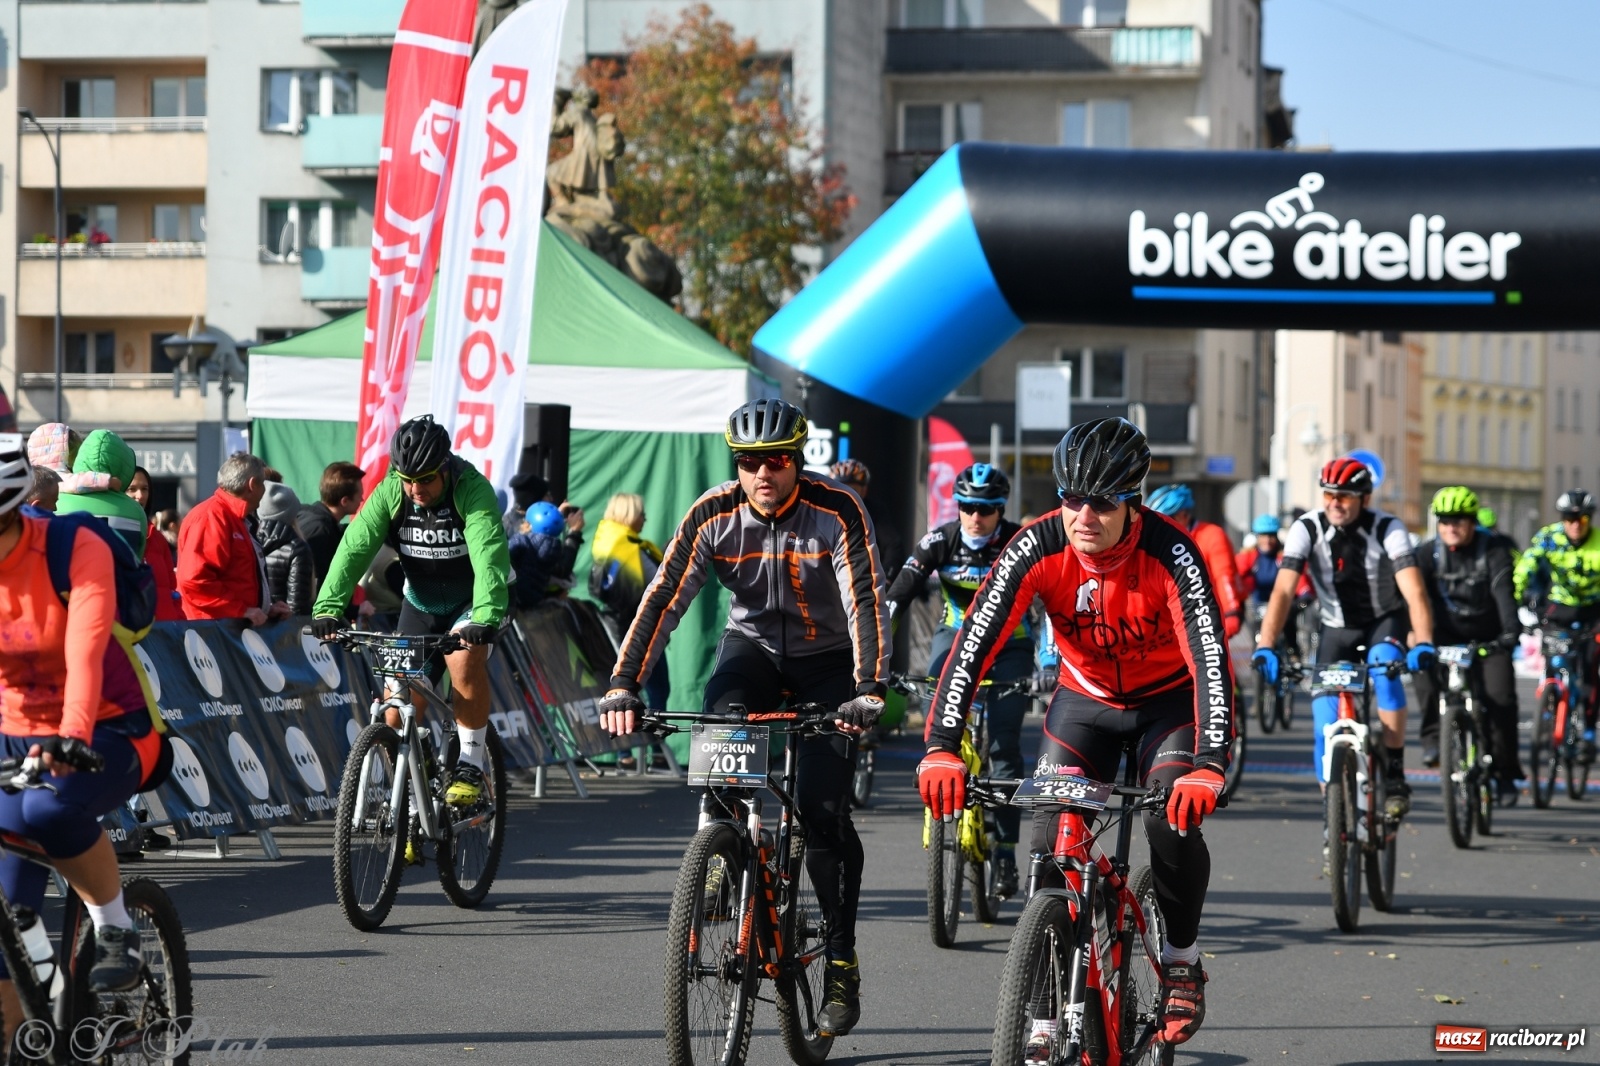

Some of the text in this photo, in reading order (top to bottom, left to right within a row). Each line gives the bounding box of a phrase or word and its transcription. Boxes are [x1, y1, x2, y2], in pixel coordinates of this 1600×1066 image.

[1128, 209, 1521, 281] bike atelier
[454, 64, 529, 482] RACIBÓR
[412, 527, 464, 544] BORA
[411, 548, 461, 558] hansgrohe
[942, 528, 1039, 728] opony-serafinowski.pl
[378, 648, 415, 657] OPIEKUN
[383, 656, 411, 670] 274
[199, 701, 243, 717] KOKOwear
[259, 696, 305, 712] KOKOwear
[701, 743, 756, 754] OPIEKUN
[710, 754, 749, 773] 101
[1033, 780, 1098, 792] OPIEKUN
[1040, 786, 1086, 799] 168
[187, 811, 234, 828] KOKOwear
[248, 803, 292, 820] KOKOwear
[738, 996, 754, 1061] MAXXIS
